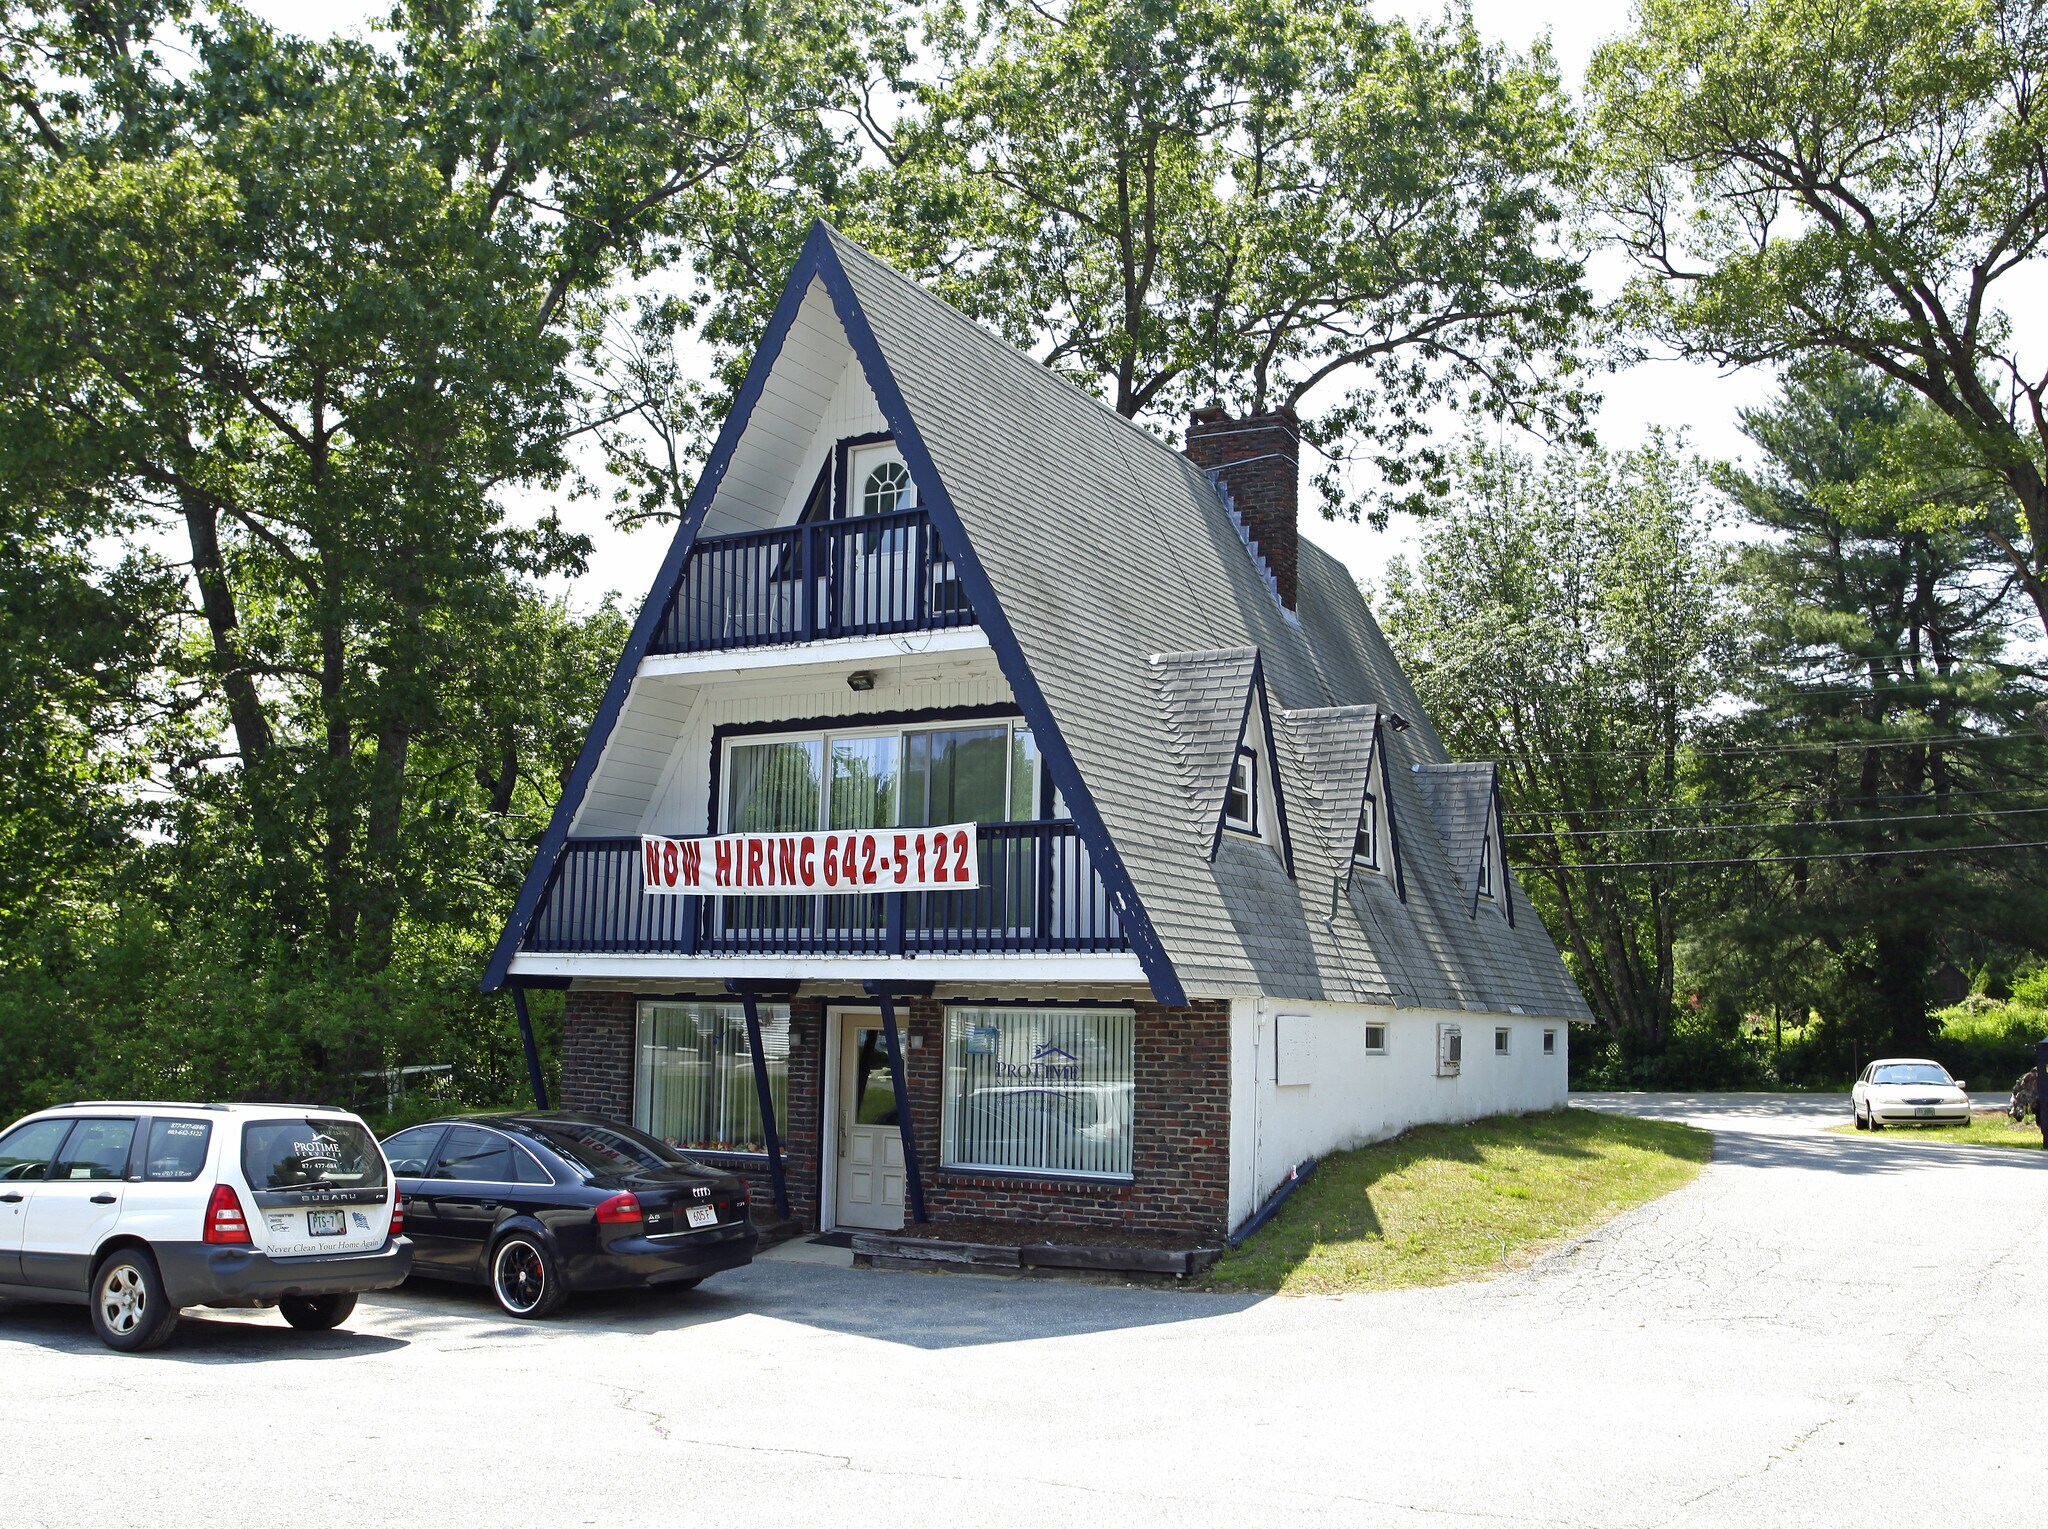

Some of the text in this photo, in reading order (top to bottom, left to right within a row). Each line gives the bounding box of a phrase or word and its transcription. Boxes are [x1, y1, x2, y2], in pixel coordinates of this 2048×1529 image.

[645, 830, 969, 887] NOW HIRING 642-5122
[312, 1215, 335, 1228] PTS-7
[266, 1244, 291, 1253] Never
[293, 1243, 316, 1253] Clean
[318, 1242, 336, 1251] Your
[338, 1241, 360, 1249] Home
